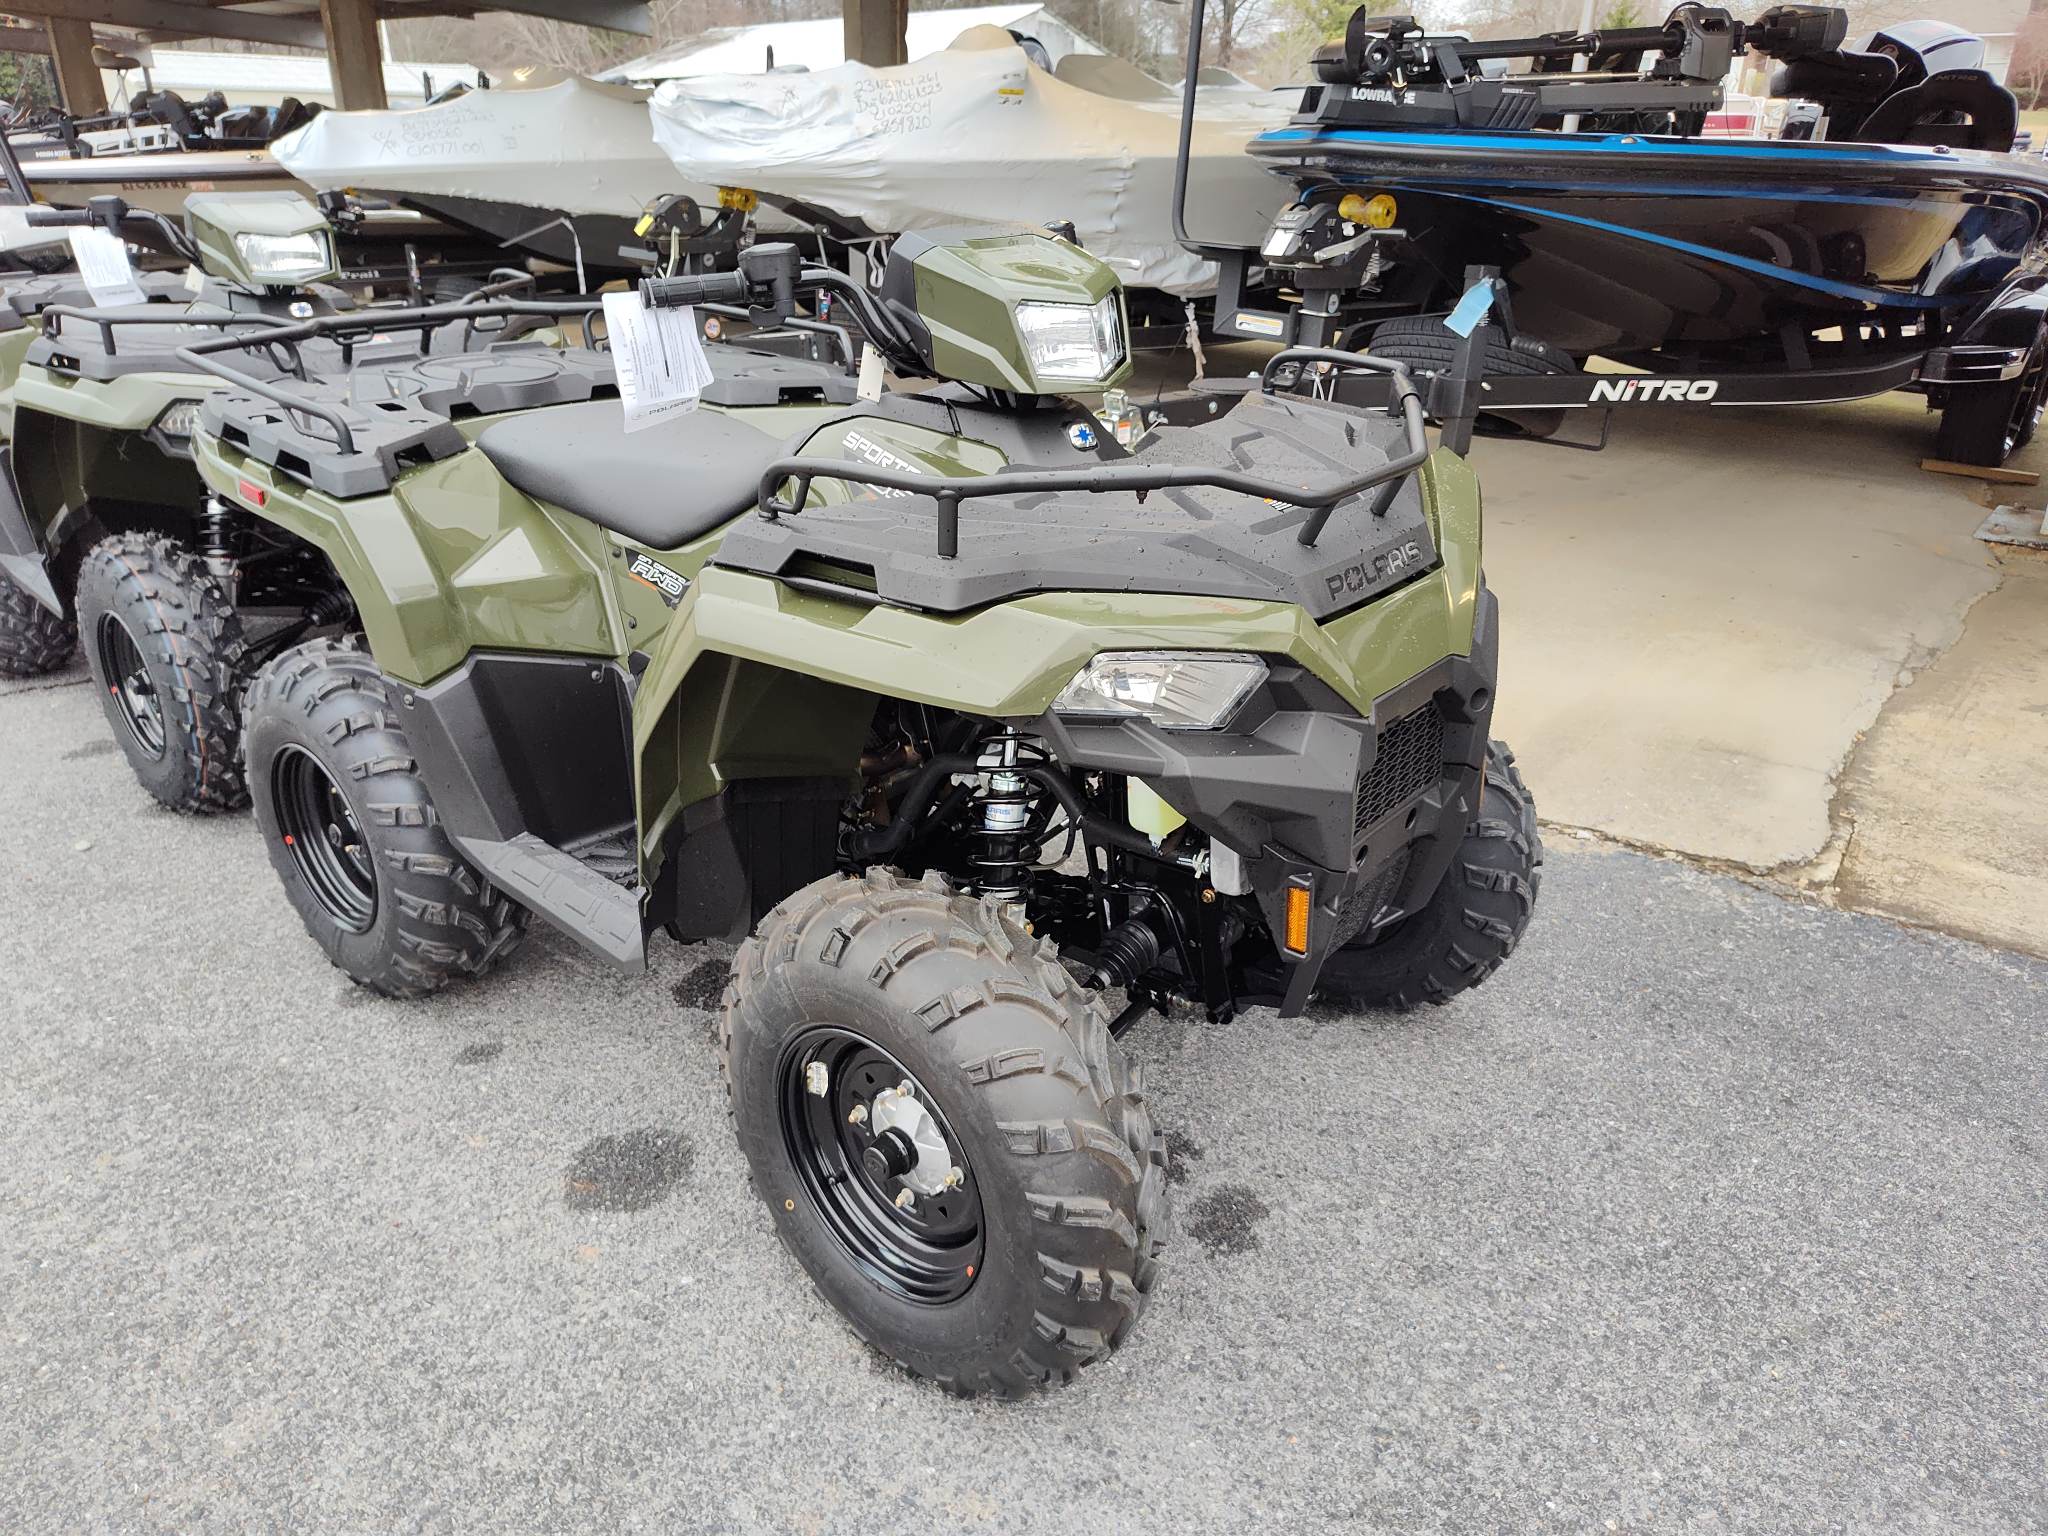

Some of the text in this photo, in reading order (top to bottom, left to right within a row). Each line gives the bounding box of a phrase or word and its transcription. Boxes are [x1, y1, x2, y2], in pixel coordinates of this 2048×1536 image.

[1352, 87, 1416, 104] LOWRAE
[1588, 379, 1719, 402] NITRO
[631, 560, 682, 595] AWD
[1325, 541, 1421, 601] POLARIS
